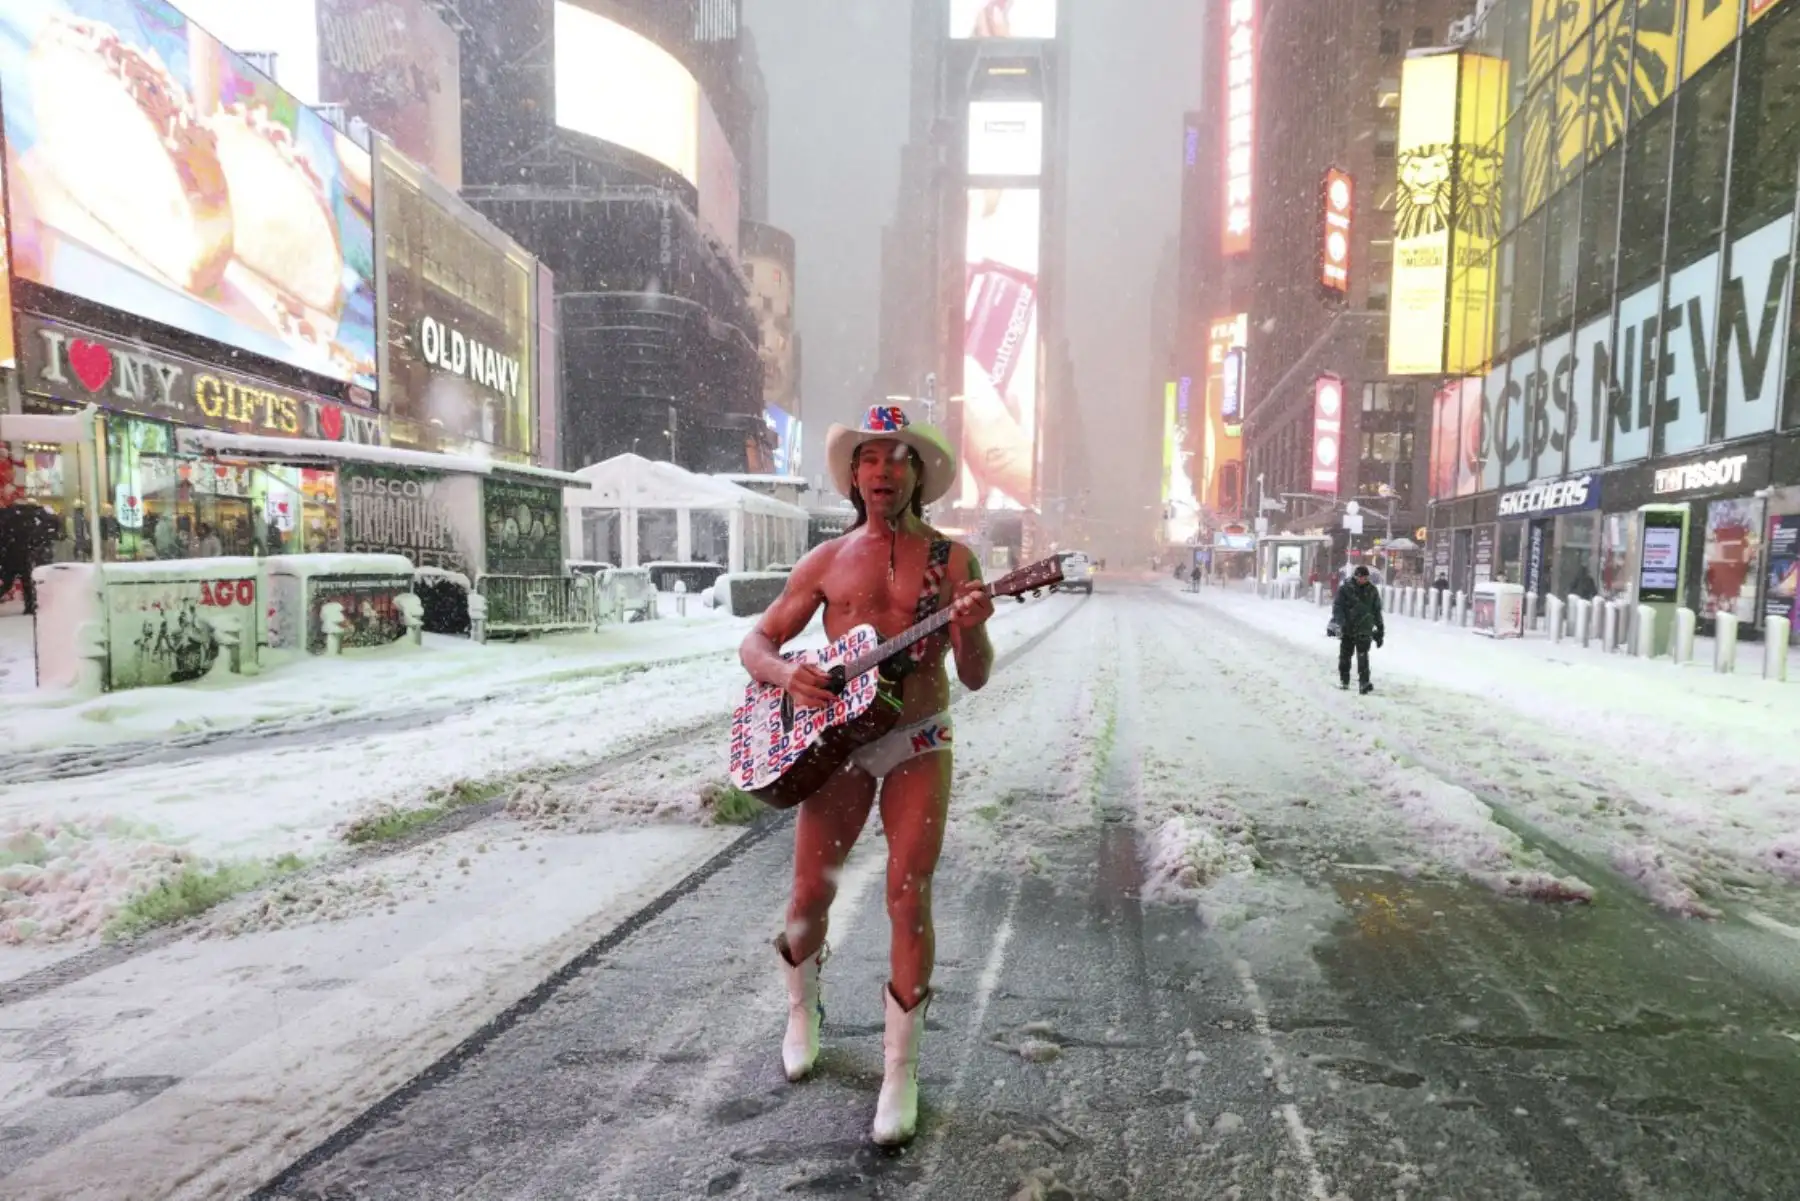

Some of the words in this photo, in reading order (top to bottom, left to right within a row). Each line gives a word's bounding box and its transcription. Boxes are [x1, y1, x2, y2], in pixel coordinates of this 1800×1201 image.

[38, 330, 69, 384] I
[422, 316, 466, 375] OLD
[470, 339, 519, 397] NAVY
[194, 373, 299, 433] GIFTS
[304, 401, 320, 437] I
[1494, 353, 1579, 465] CBS
[1499, 475, 1592, 516] SKECHERS
[818, 630, 866, 663] NAKED
[730, 706, 744, 773] OYSTERS
[911, 724, 952, 753] NYC
